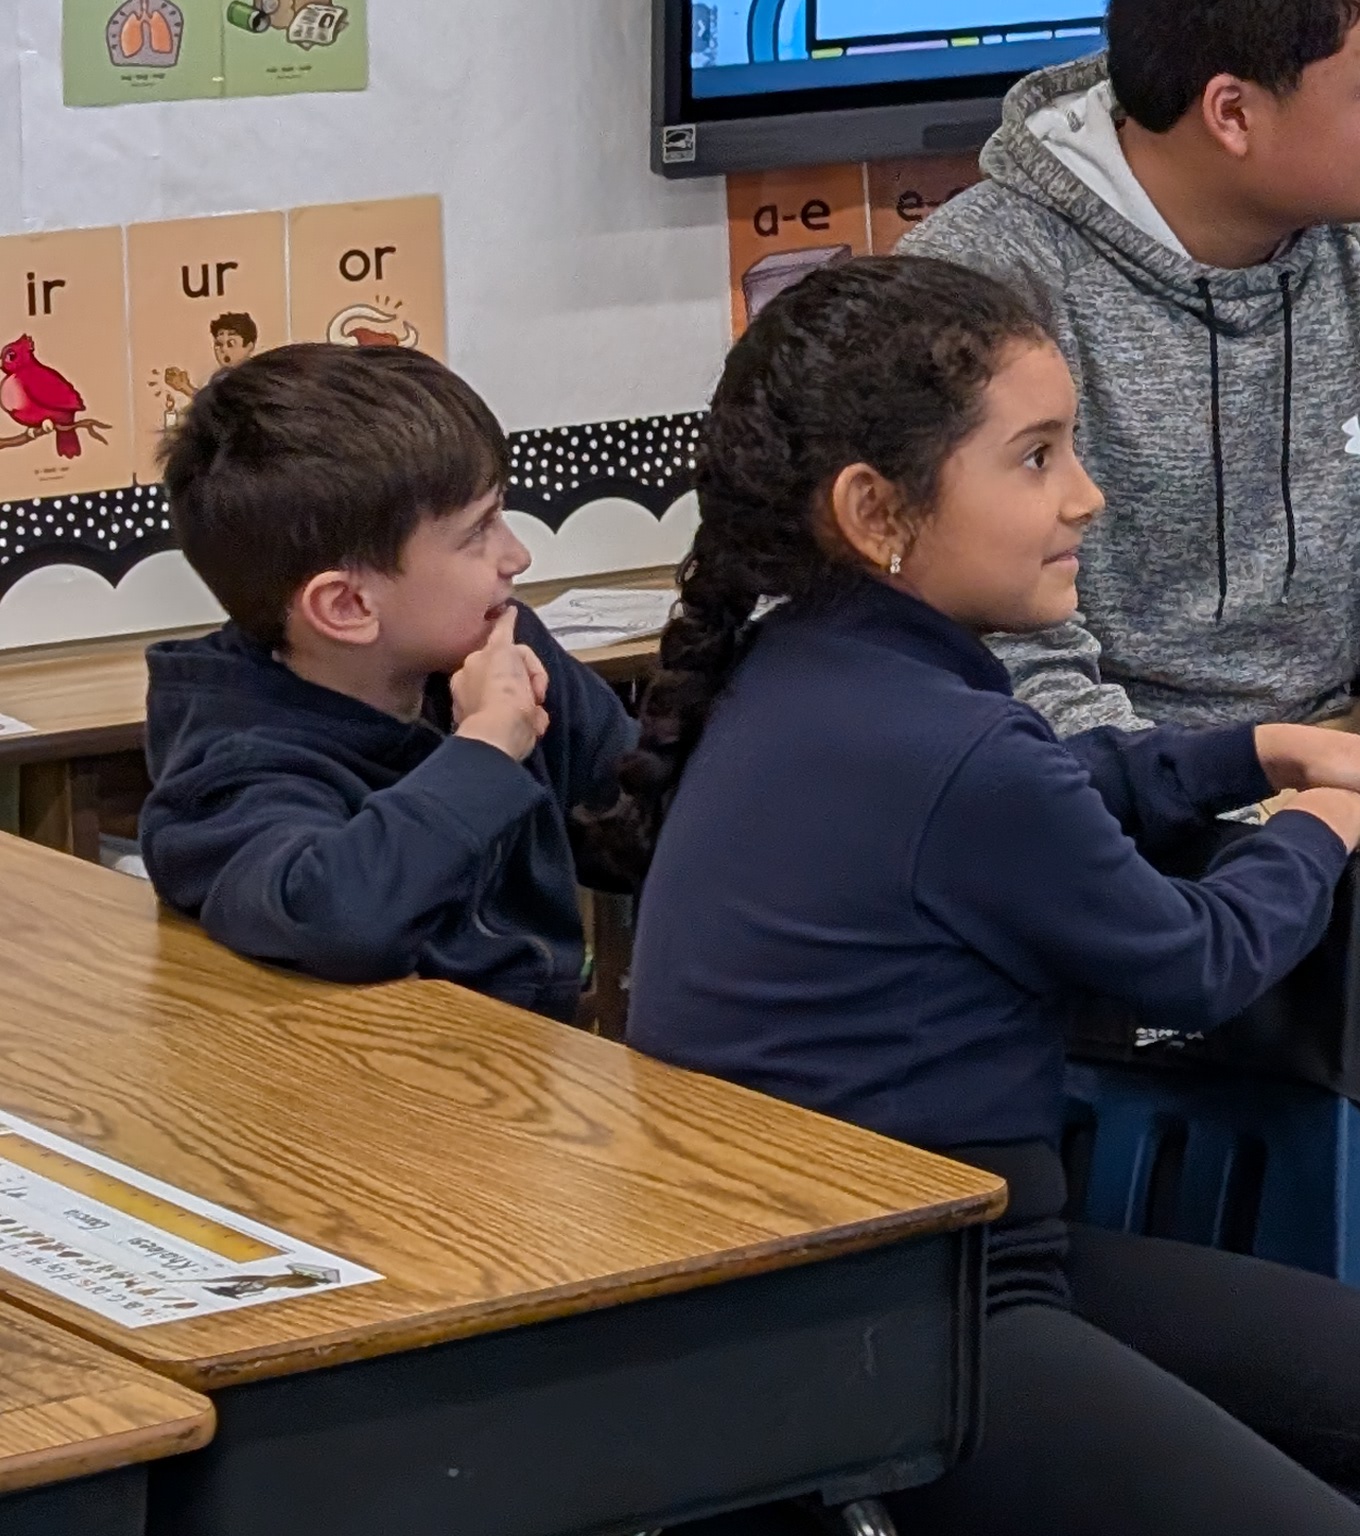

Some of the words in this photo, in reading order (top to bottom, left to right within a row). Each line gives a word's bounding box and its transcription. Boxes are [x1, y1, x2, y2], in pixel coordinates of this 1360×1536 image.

[753, 199, 830, 237] a-e
[181, 256, 238, 300] ur
[339, 242, 397, 283] or
[26, 271, 66, 318] ir
